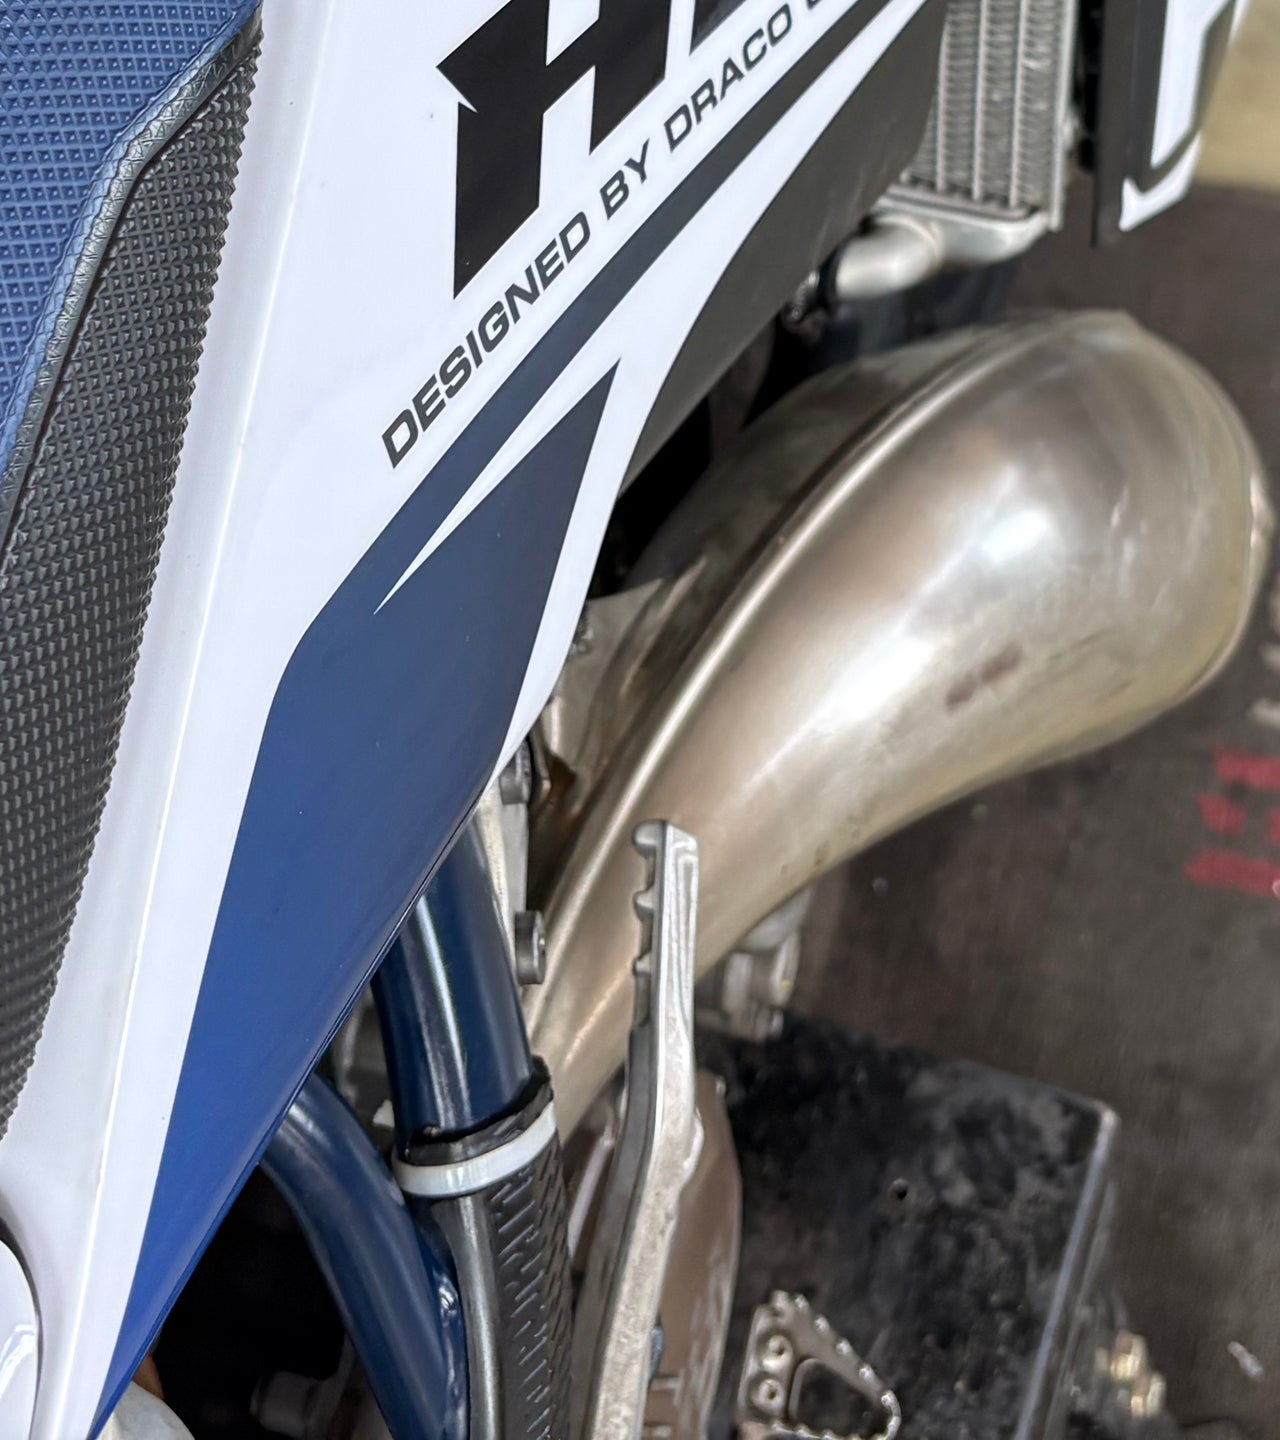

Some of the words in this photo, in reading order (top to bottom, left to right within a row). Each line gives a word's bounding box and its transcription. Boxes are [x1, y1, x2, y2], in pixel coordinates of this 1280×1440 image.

[381, 210, 591, 469] DESIGNED
[598, 138, 651, 221] BY
[663, 4, 793, 154] DRACO
